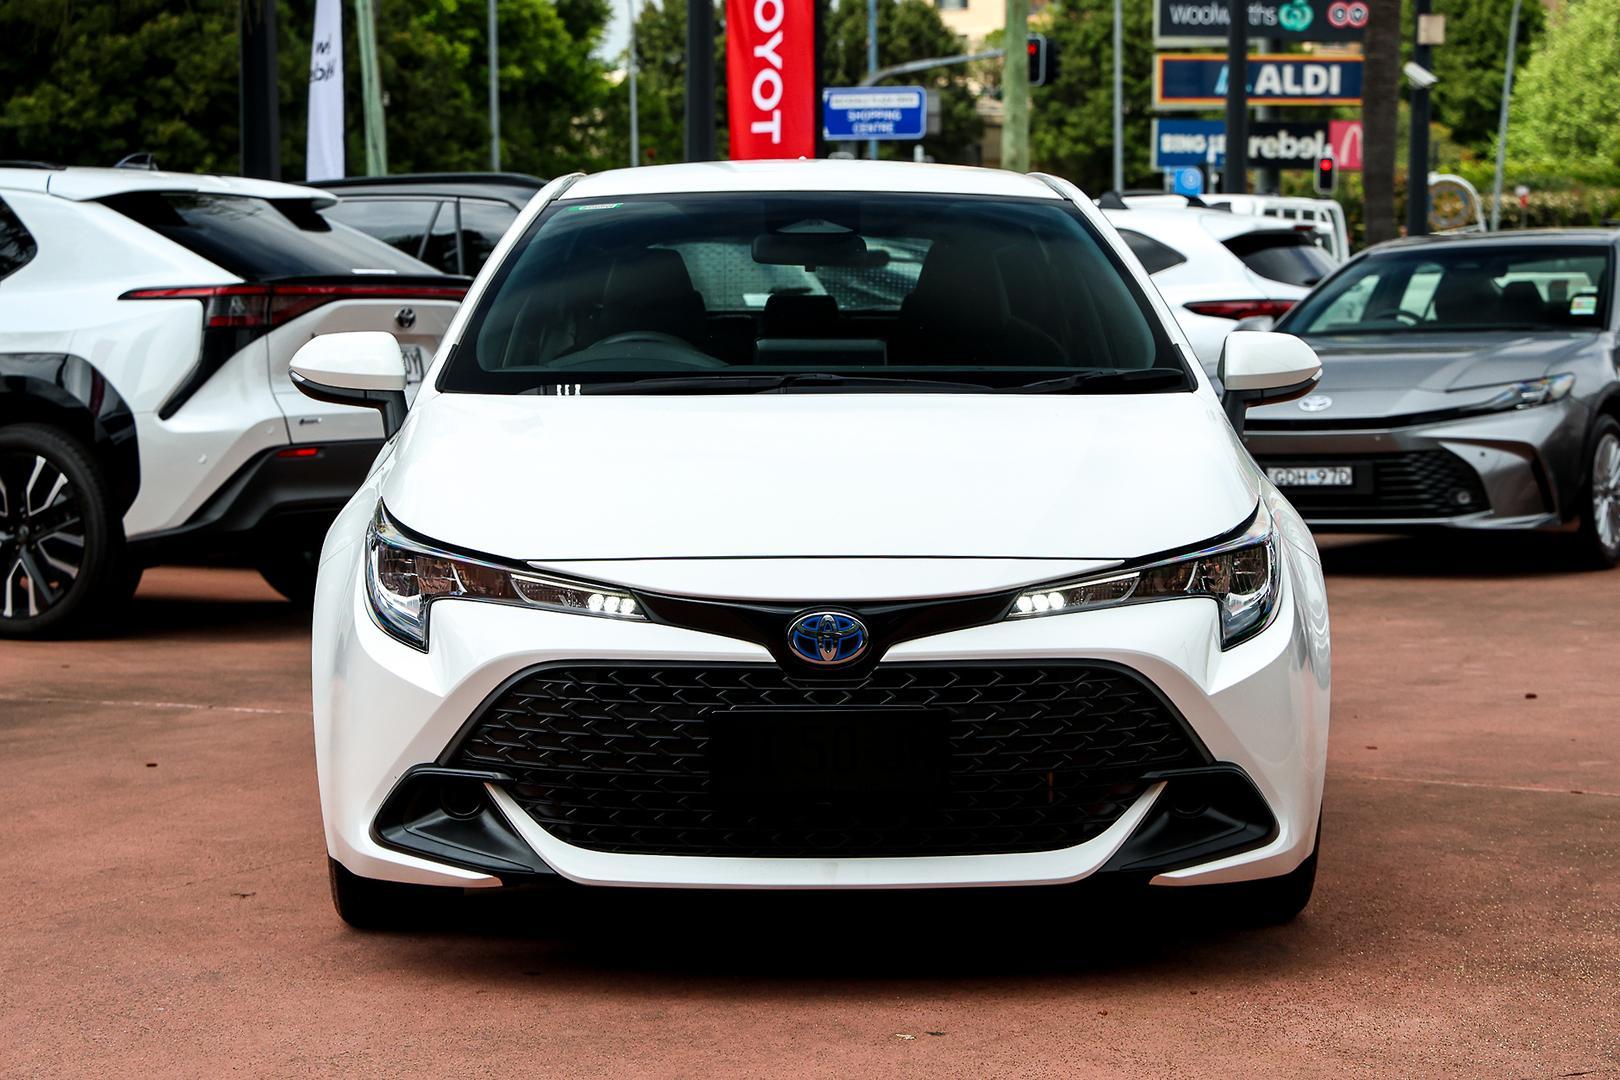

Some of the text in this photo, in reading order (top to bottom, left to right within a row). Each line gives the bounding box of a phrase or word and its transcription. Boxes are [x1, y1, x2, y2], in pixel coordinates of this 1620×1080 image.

[1254, 64, 1342, 95] ALDI
[847, 109, 902, 122] SHOPPING
[852, 122, 896, 135] CENTRE
[1248, 129, 1325, 159] rebel
